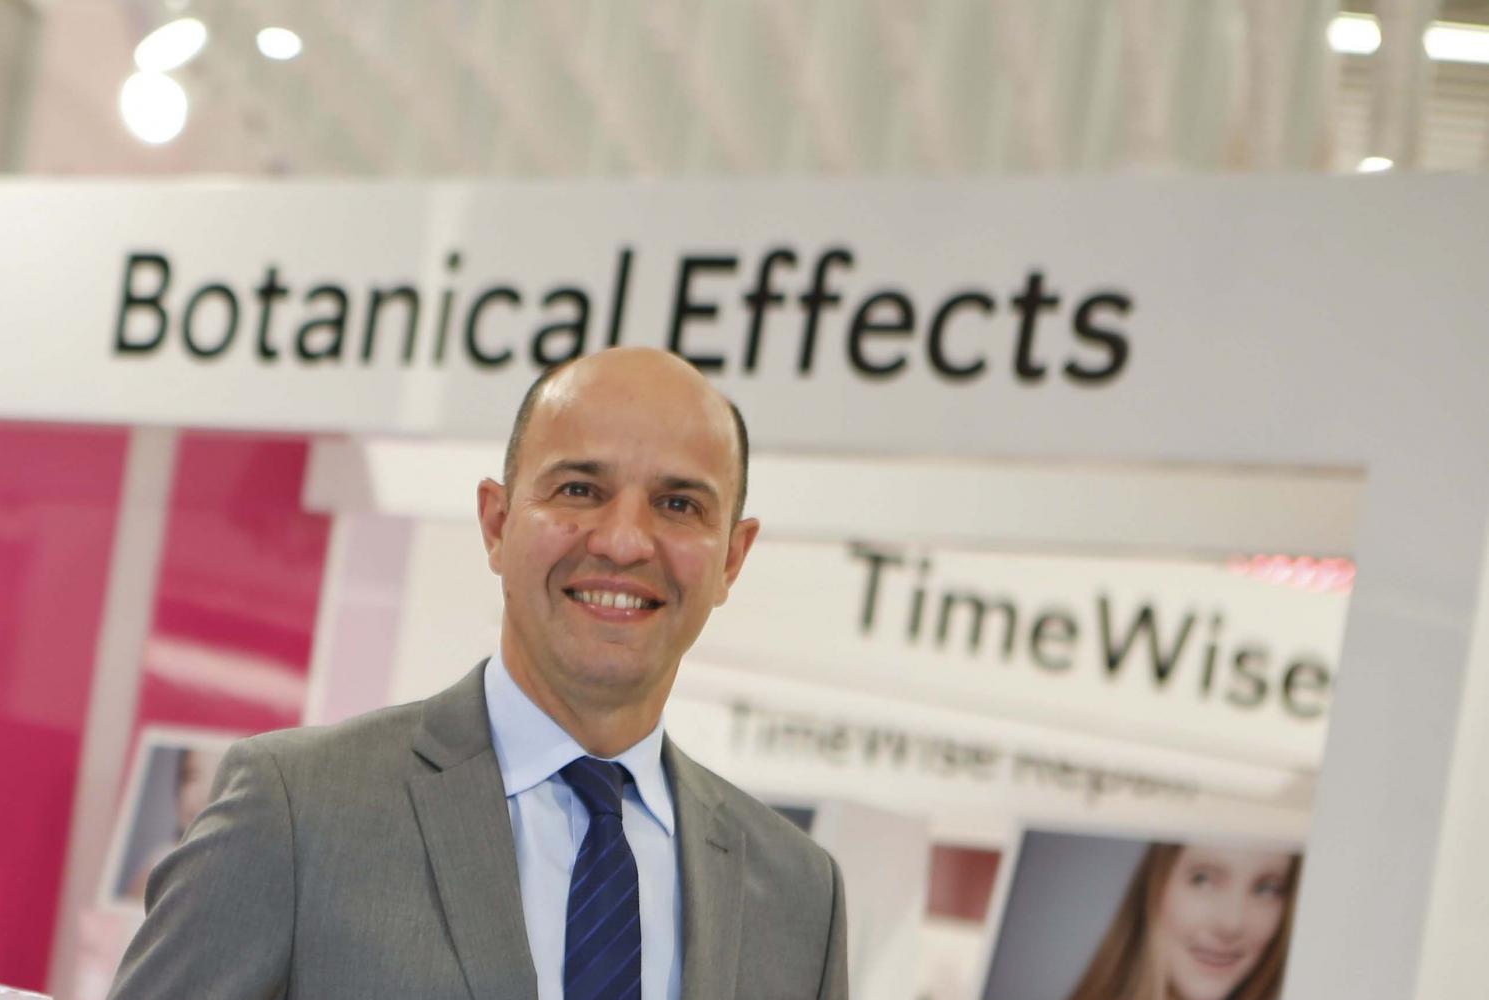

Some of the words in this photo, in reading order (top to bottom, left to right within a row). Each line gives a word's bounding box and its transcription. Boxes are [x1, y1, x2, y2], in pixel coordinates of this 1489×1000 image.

[113, 247, 633, 369] Botanical
[667, 246, 1134, 386] Effects
[848, 541, 1330, 721] TimeWise
